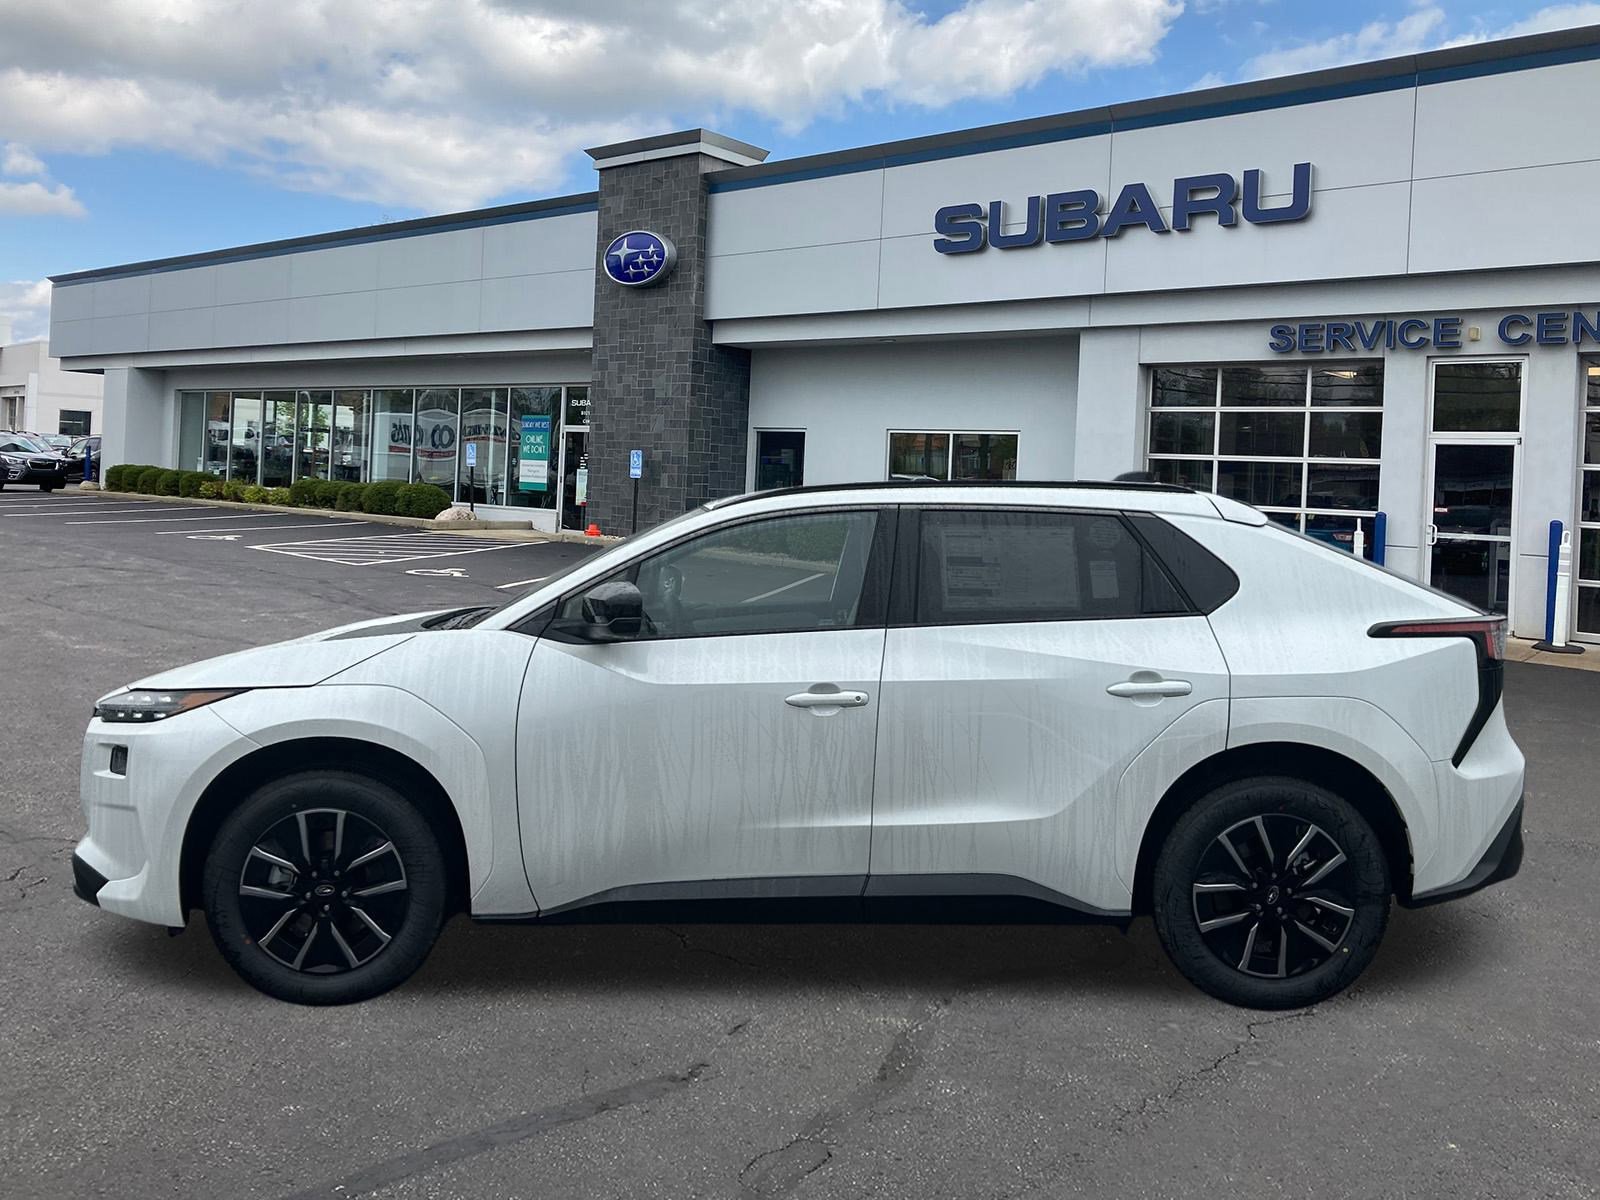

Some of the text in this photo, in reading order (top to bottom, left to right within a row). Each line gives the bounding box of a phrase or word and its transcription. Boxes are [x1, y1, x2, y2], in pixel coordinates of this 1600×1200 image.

[934, 161, 1313, 255] SUBARU
[1268, 311, 1600, 353] SERVICE CEN
